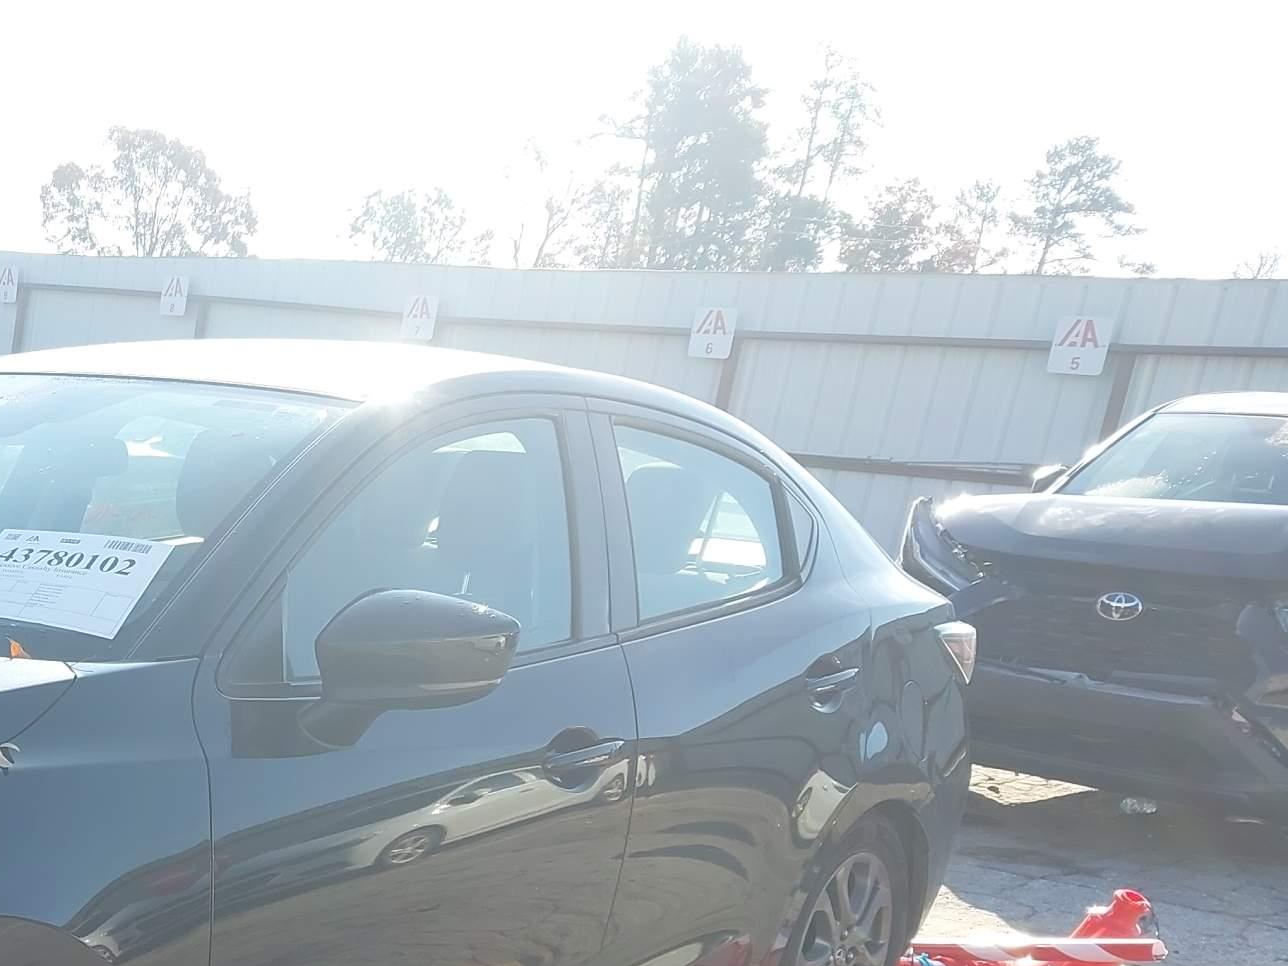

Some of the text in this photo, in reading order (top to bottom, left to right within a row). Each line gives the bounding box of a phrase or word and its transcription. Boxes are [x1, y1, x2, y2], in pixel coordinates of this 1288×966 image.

[705, 342, 713, 354] 6
[1070, 356, 1081, 371] 5
[0, 546, 137, 576] 43780102
